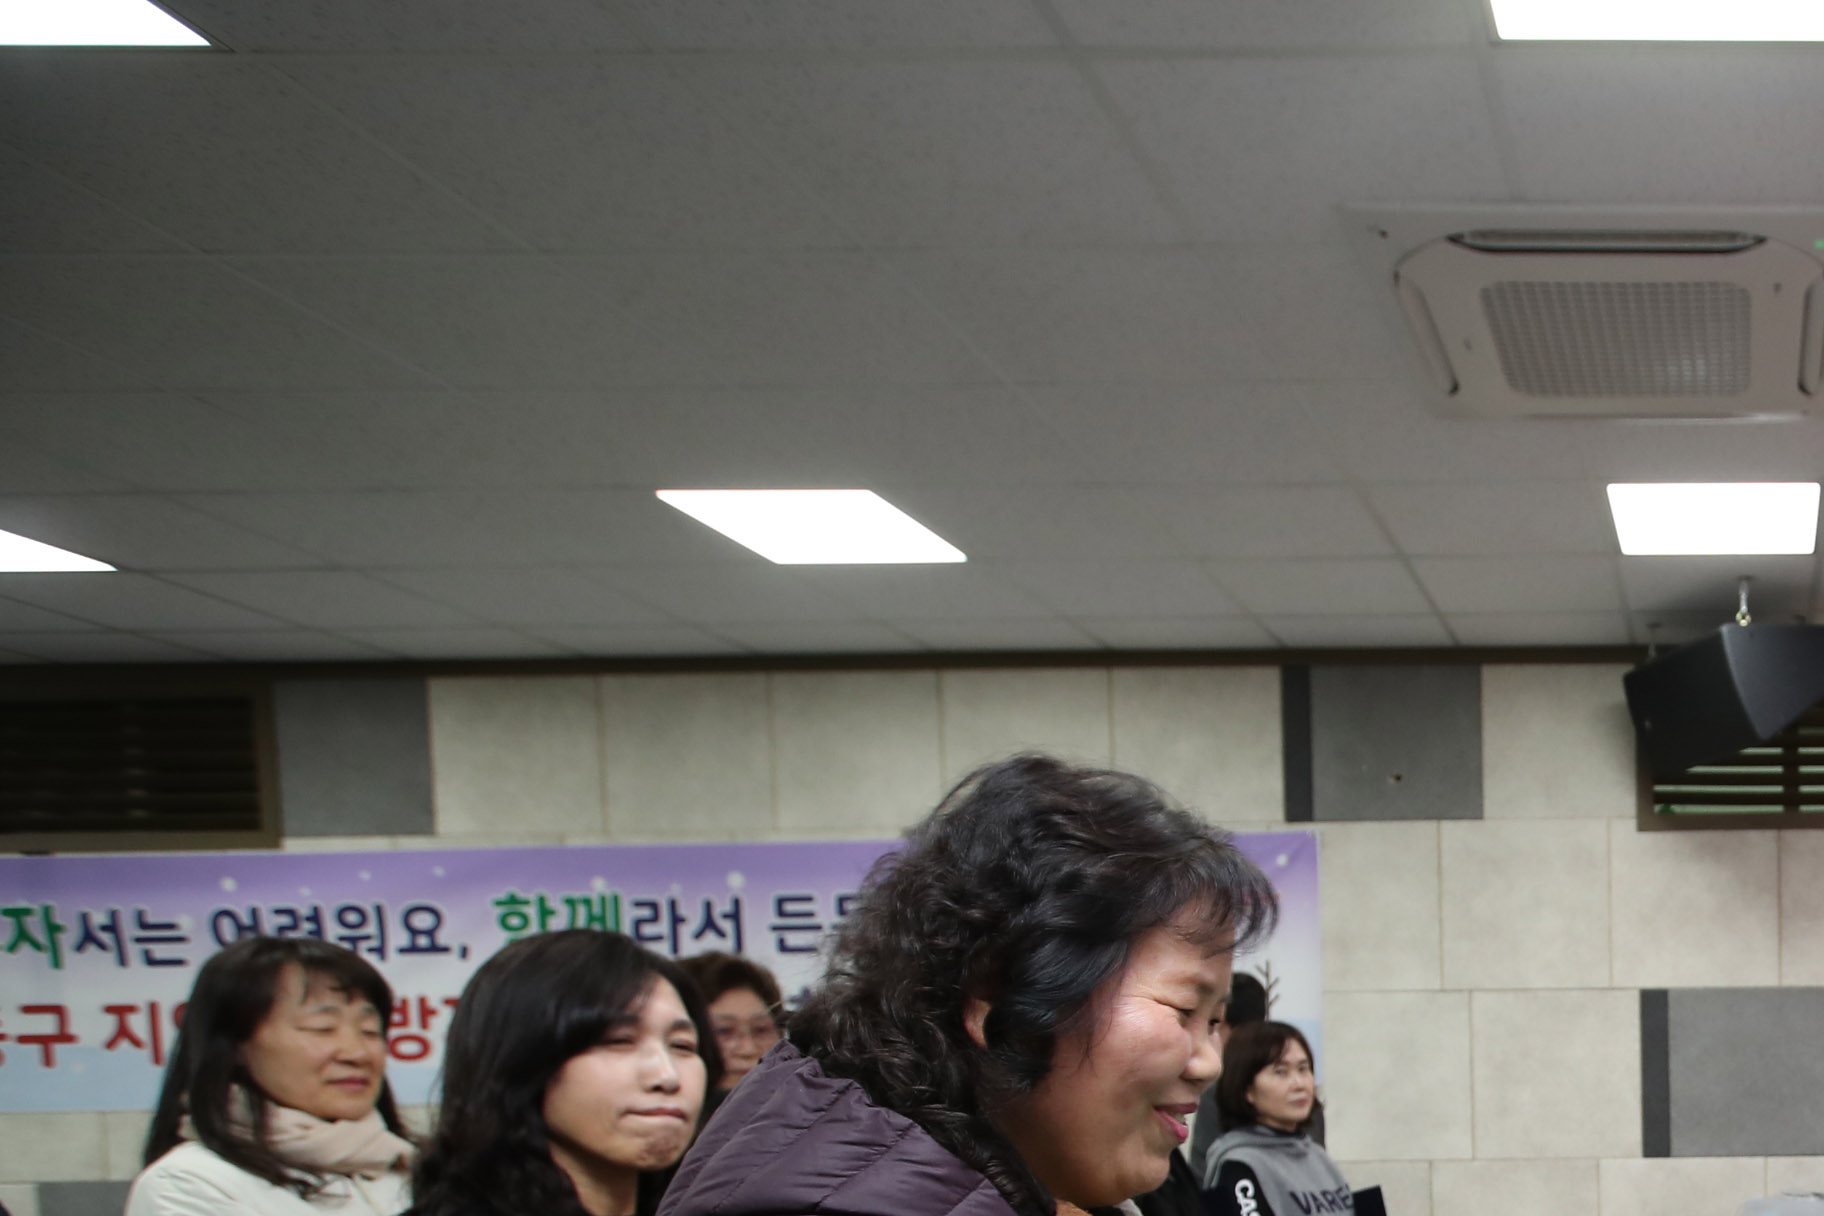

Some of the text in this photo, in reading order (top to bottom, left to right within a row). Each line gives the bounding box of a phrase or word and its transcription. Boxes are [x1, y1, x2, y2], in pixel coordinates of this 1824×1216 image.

[0, 996, 458, 1068] 구 지 방
